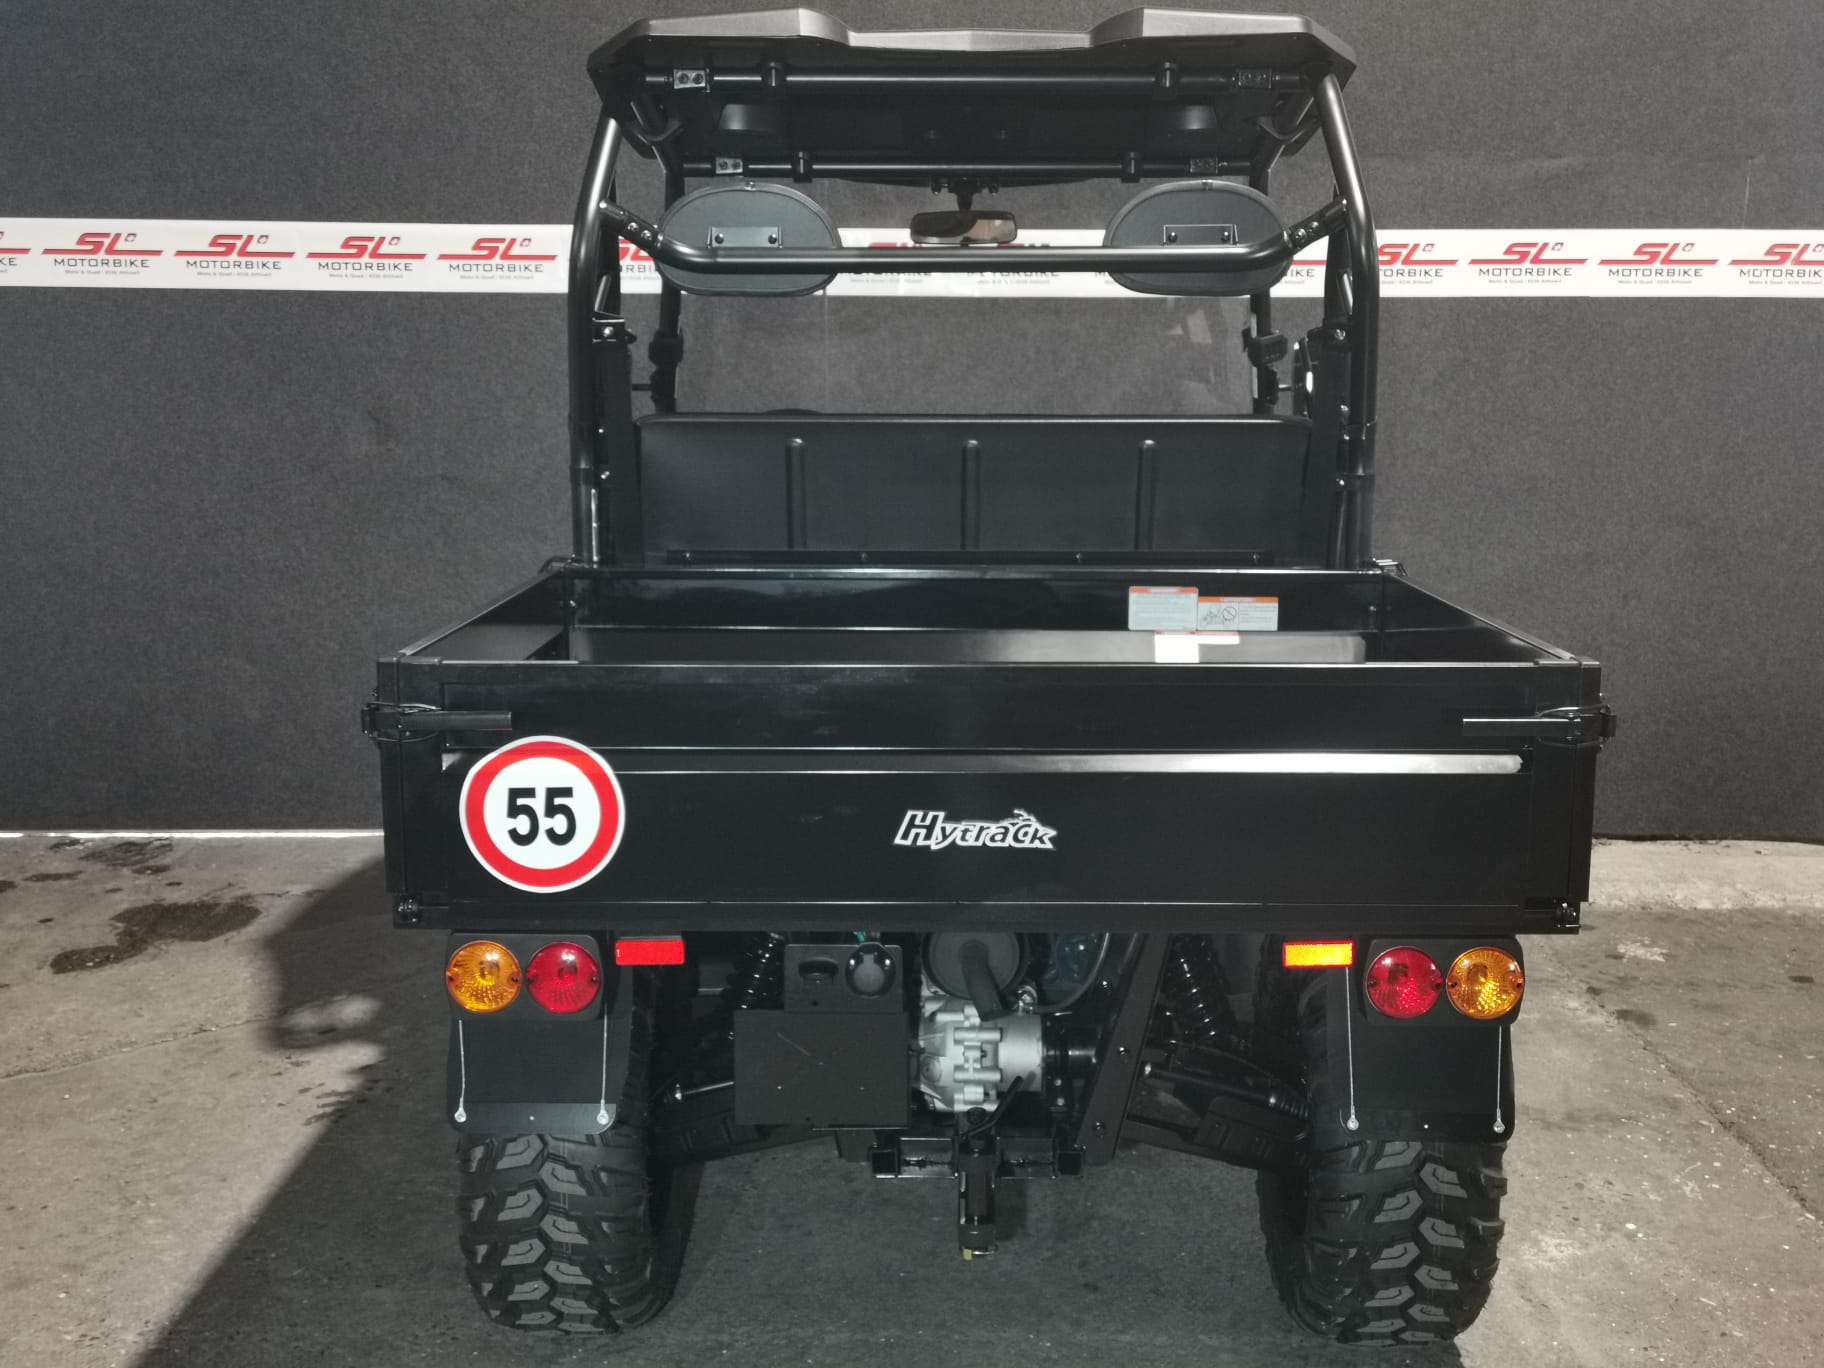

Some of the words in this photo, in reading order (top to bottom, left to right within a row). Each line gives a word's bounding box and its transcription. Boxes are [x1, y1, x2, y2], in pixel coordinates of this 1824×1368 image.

[53, 258, 150, 268] MOTORBIKE
[186, 260, 282, 270] MOTORBIKE
[318, 261, 414, 271] MOTORBIKE
[449, 263, 544, 273] MOTORBIKE
[1478, 267, 1573, 277] MOTORBIKE
[1608, 268, 1704, 278] MOTORBIKE
[1739, 268, 1824, 278] MOTORBIK
[507, 786, 577, 847] 55
[893, 809, 1058, 851] Hytrack
